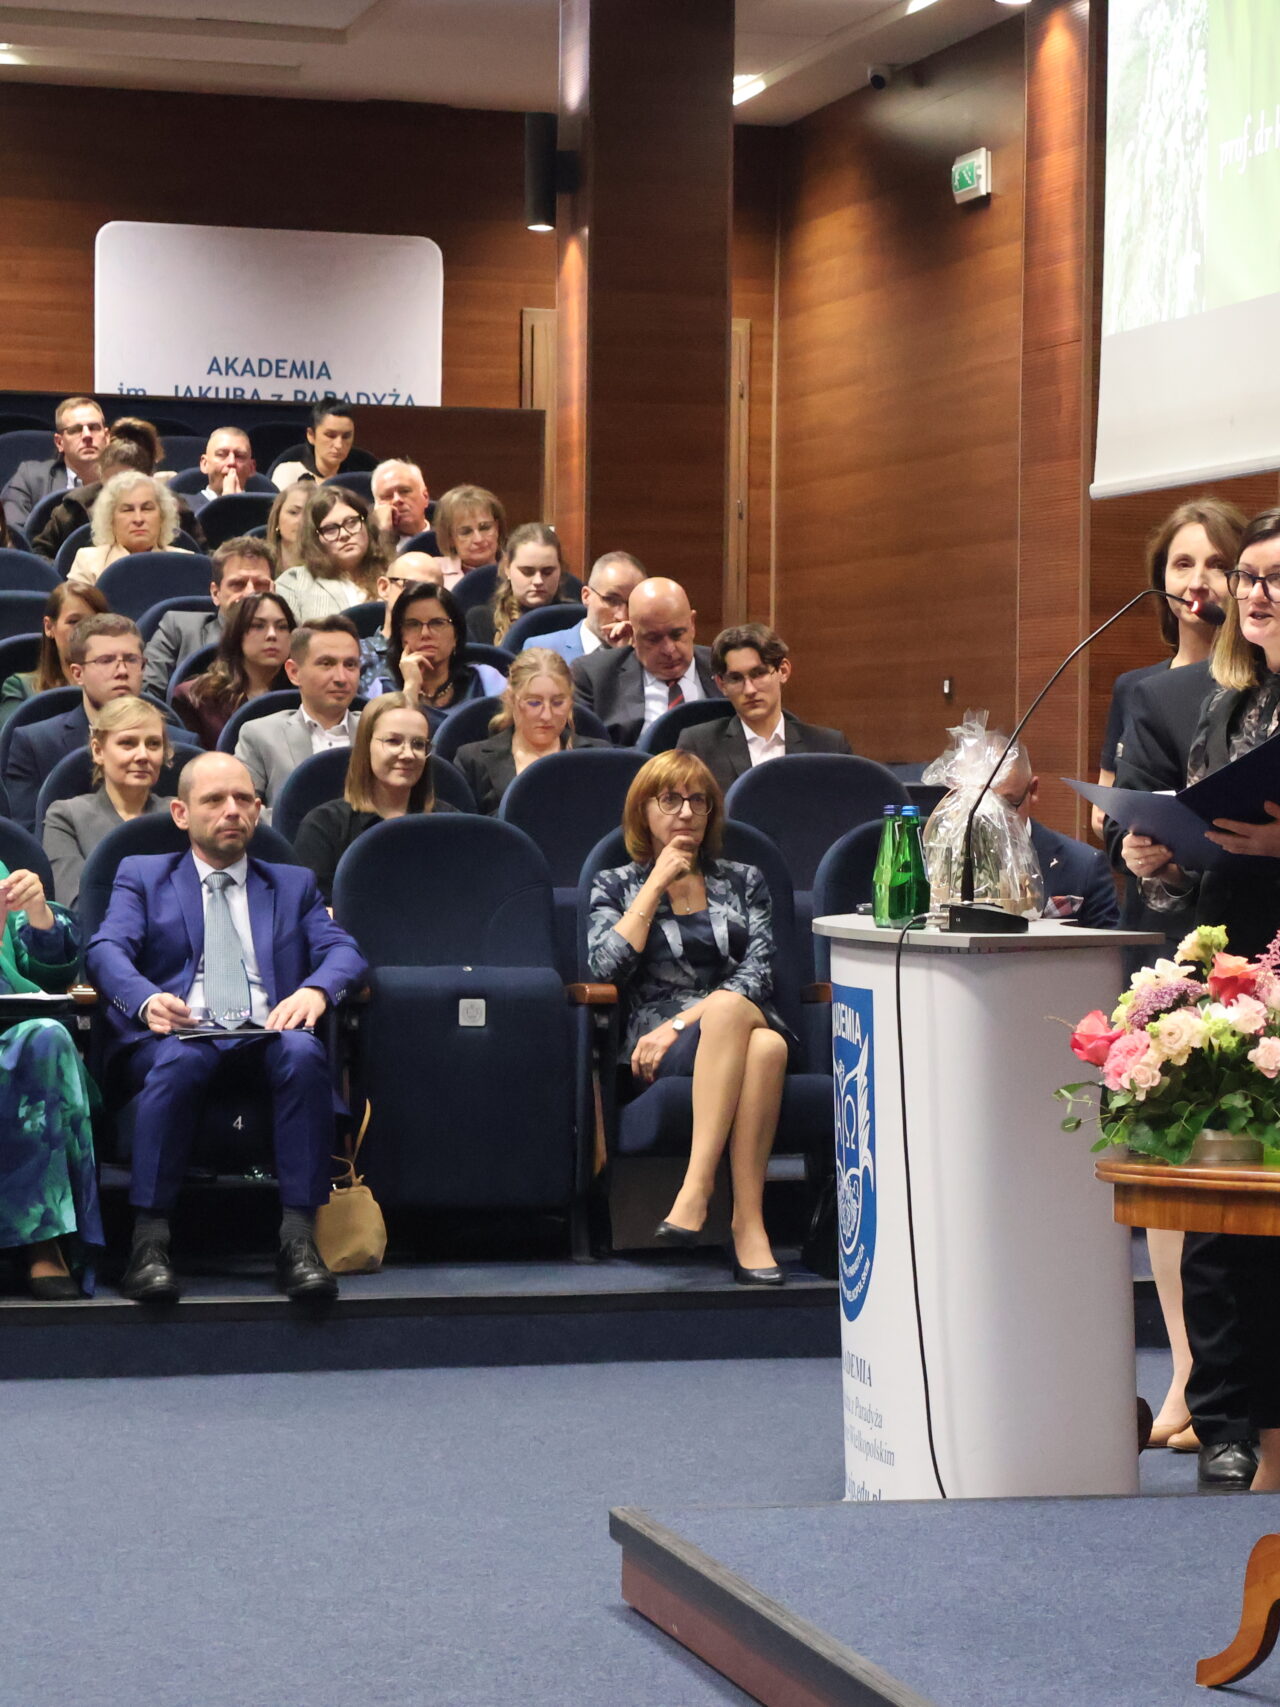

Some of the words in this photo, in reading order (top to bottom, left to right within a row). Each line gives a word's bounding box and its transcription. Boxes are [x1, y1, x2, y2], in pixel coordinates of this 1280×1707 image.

[1219, 113, 1253, 182] prof.
[1254, 109, 1273, 156] dr
[206, 356, 332, 380] AKADEMIA
[232, 1115, 244, 1130] 4
